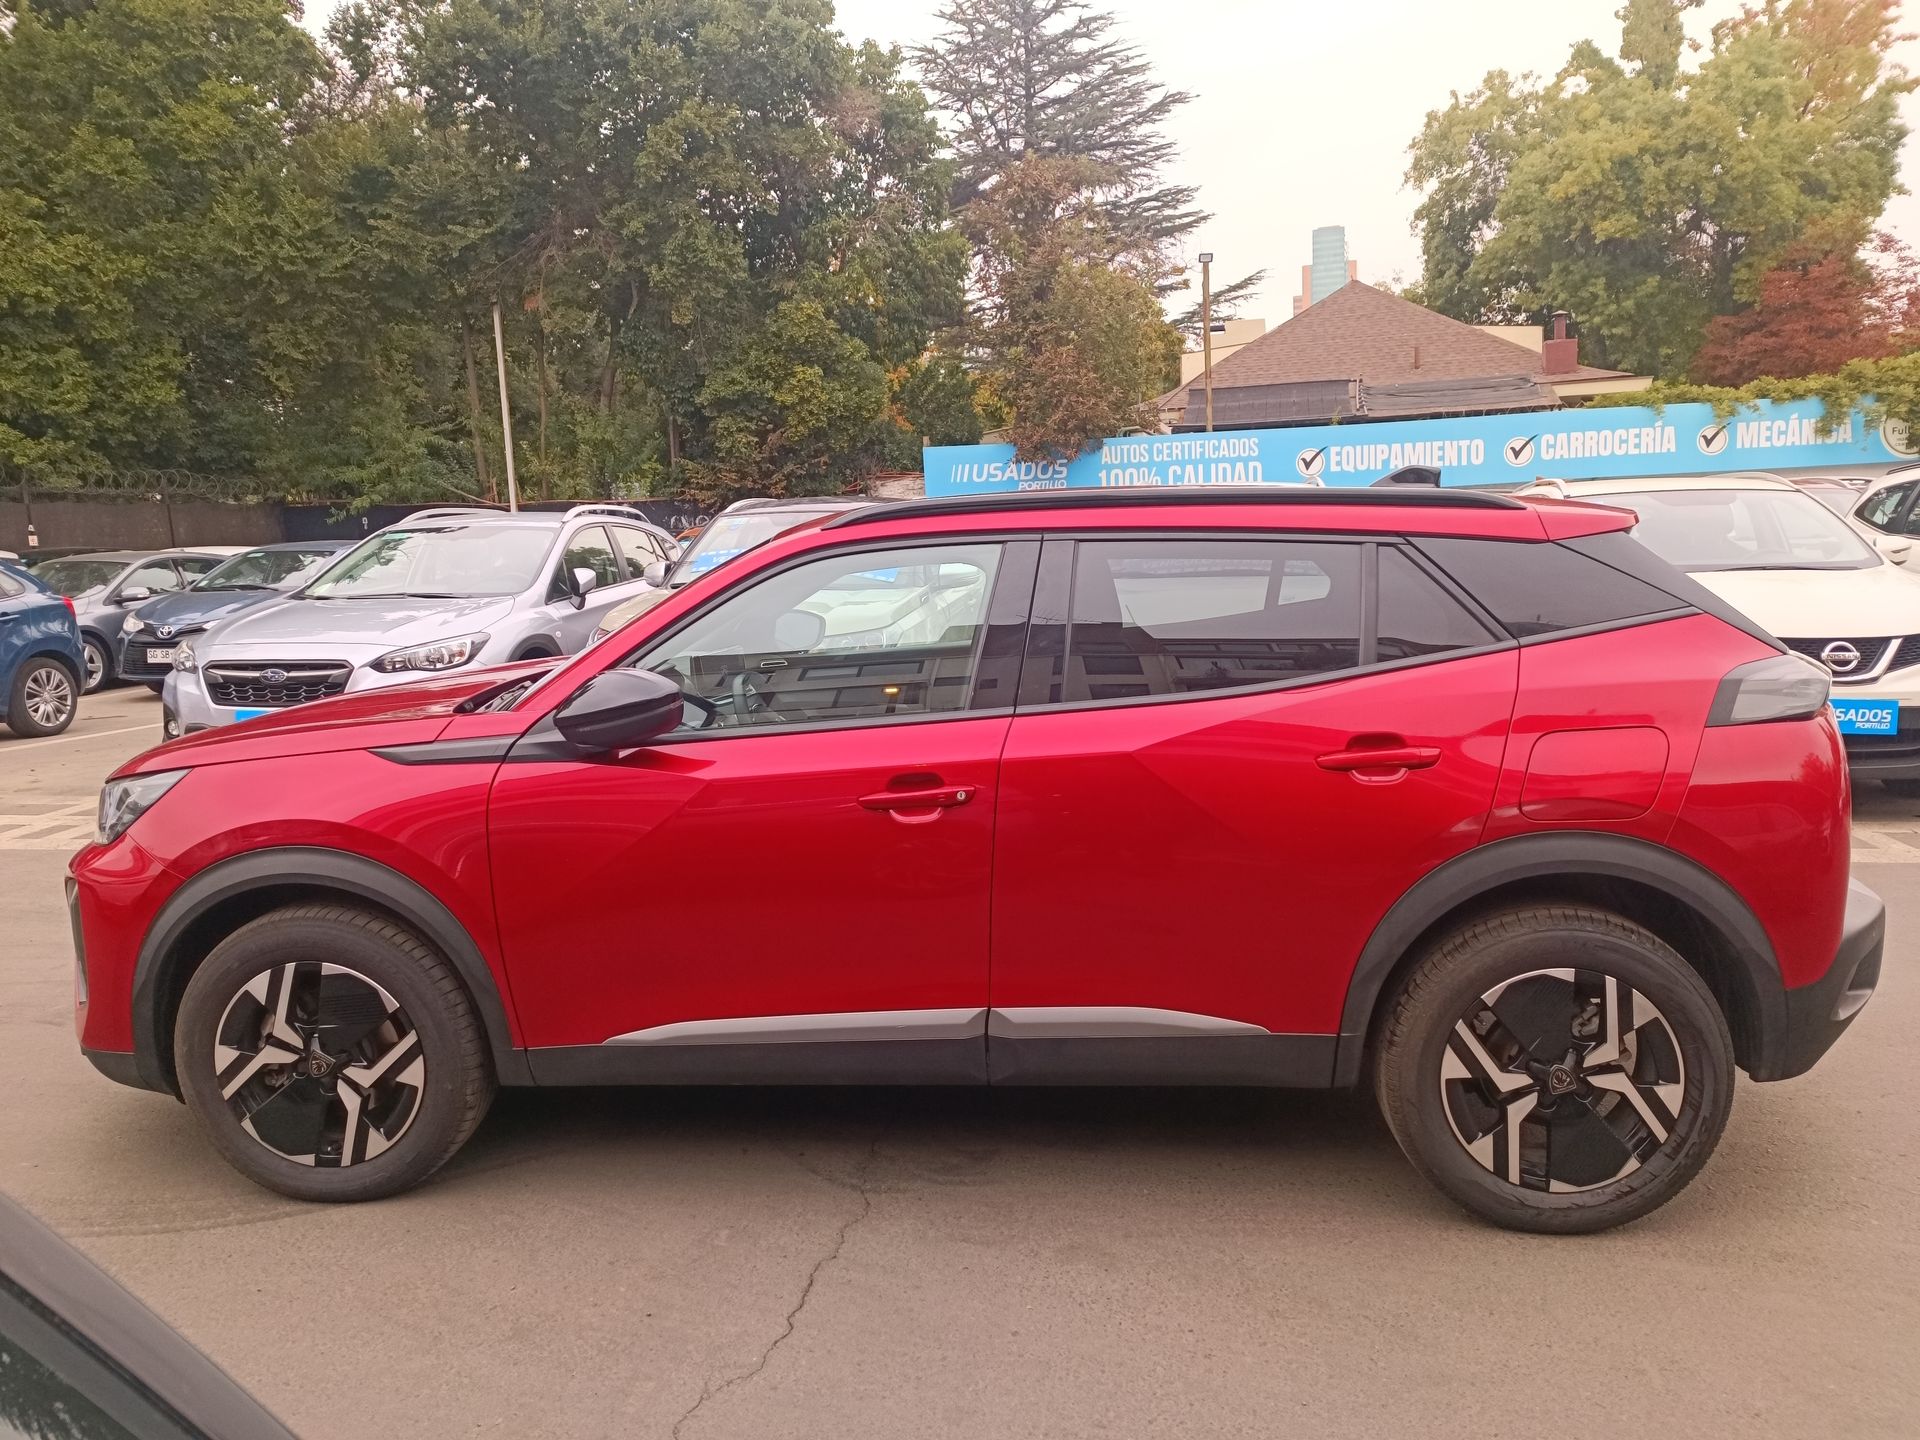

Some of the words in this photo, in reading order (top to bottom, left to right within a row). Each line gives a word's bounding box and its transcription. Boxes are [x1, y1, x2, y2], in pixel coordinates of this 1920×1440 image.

[1540, 420, 1676, 460] CARROCERÍA
[1736, 413, 1853, 449] MECÁNCA
[1101, 444, 1149, 464] AUTOS
[1153, 438, 1259, 461] CERTIFICADOS
[1330, 439, 1485, 472] EQUIPAMIENTO
[972, 459, 1068, 482] USADOS
[1099, 466, 1161, 487] 100%
[1168, 461, 1263, 486] CALIDAD
[1018, 479, 1067, 491] PORTILLO
[1833, 708, 1893, 722] SADOS
